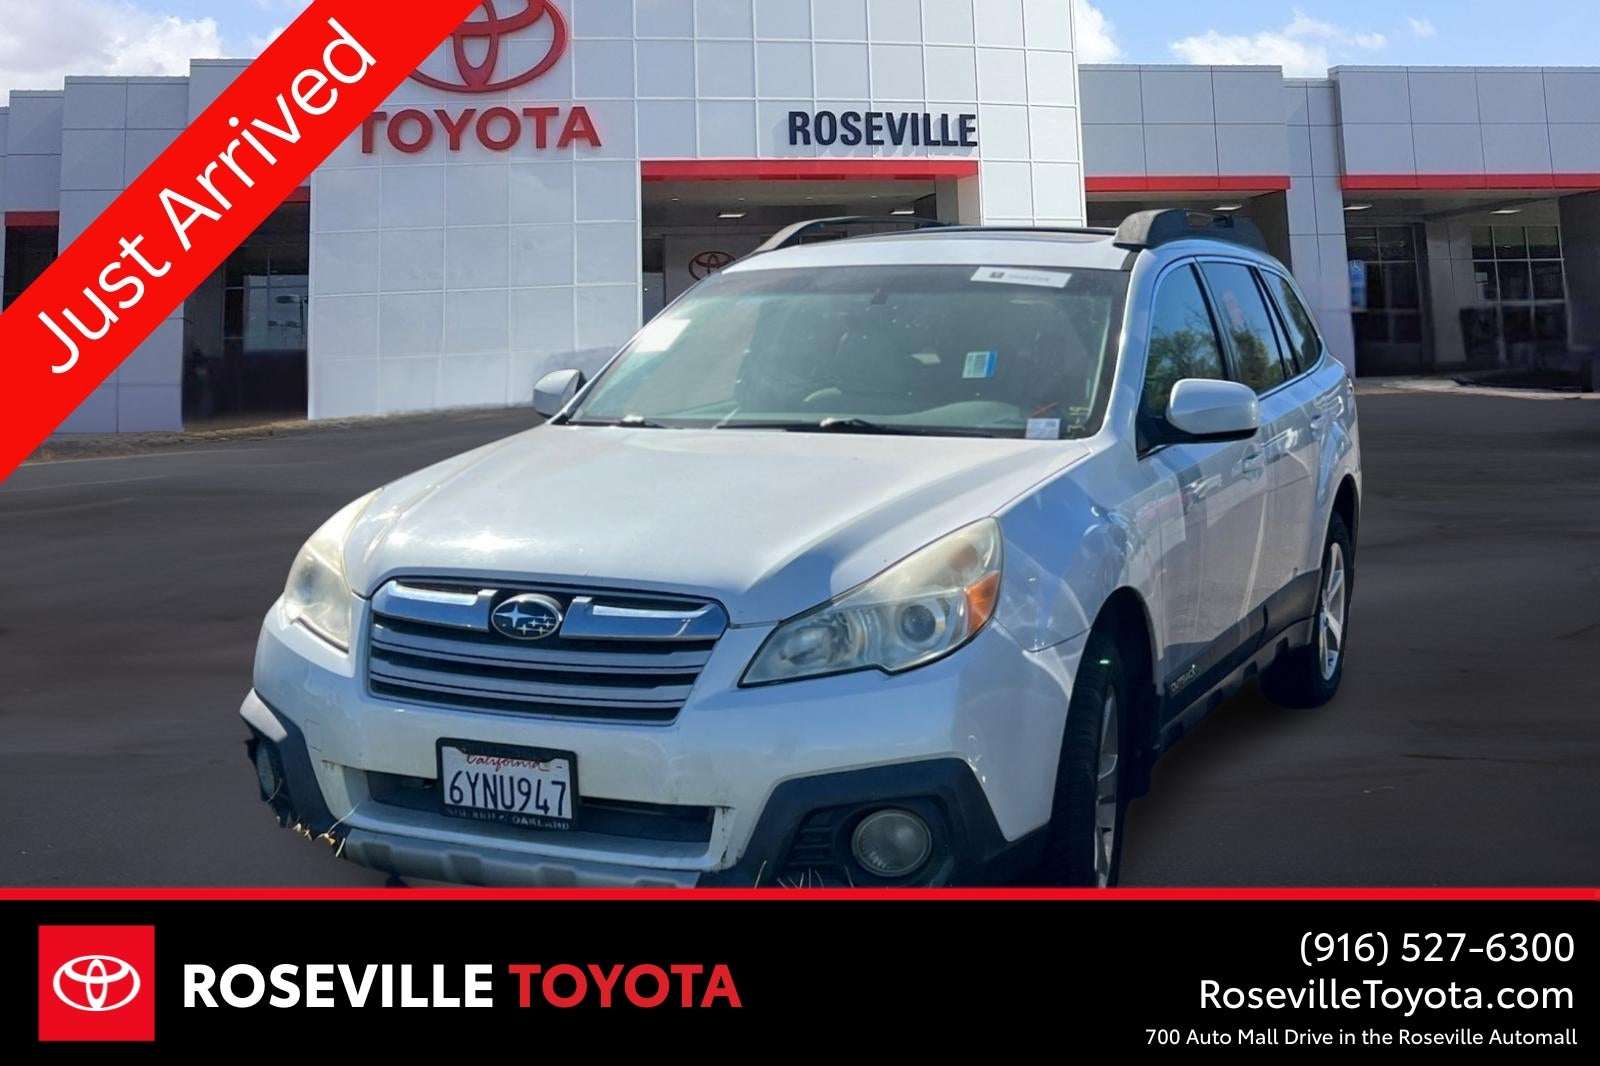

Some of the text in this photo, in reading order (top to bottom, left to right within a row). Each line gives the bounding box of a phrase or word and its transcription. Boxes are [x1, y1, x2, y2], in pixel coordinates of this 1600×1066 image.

[361, 106, 602, 154] TOYOTA
[788, 110, 978, 147] ROSEVILLE
[449, 770, 567, 817] 6YNU947
